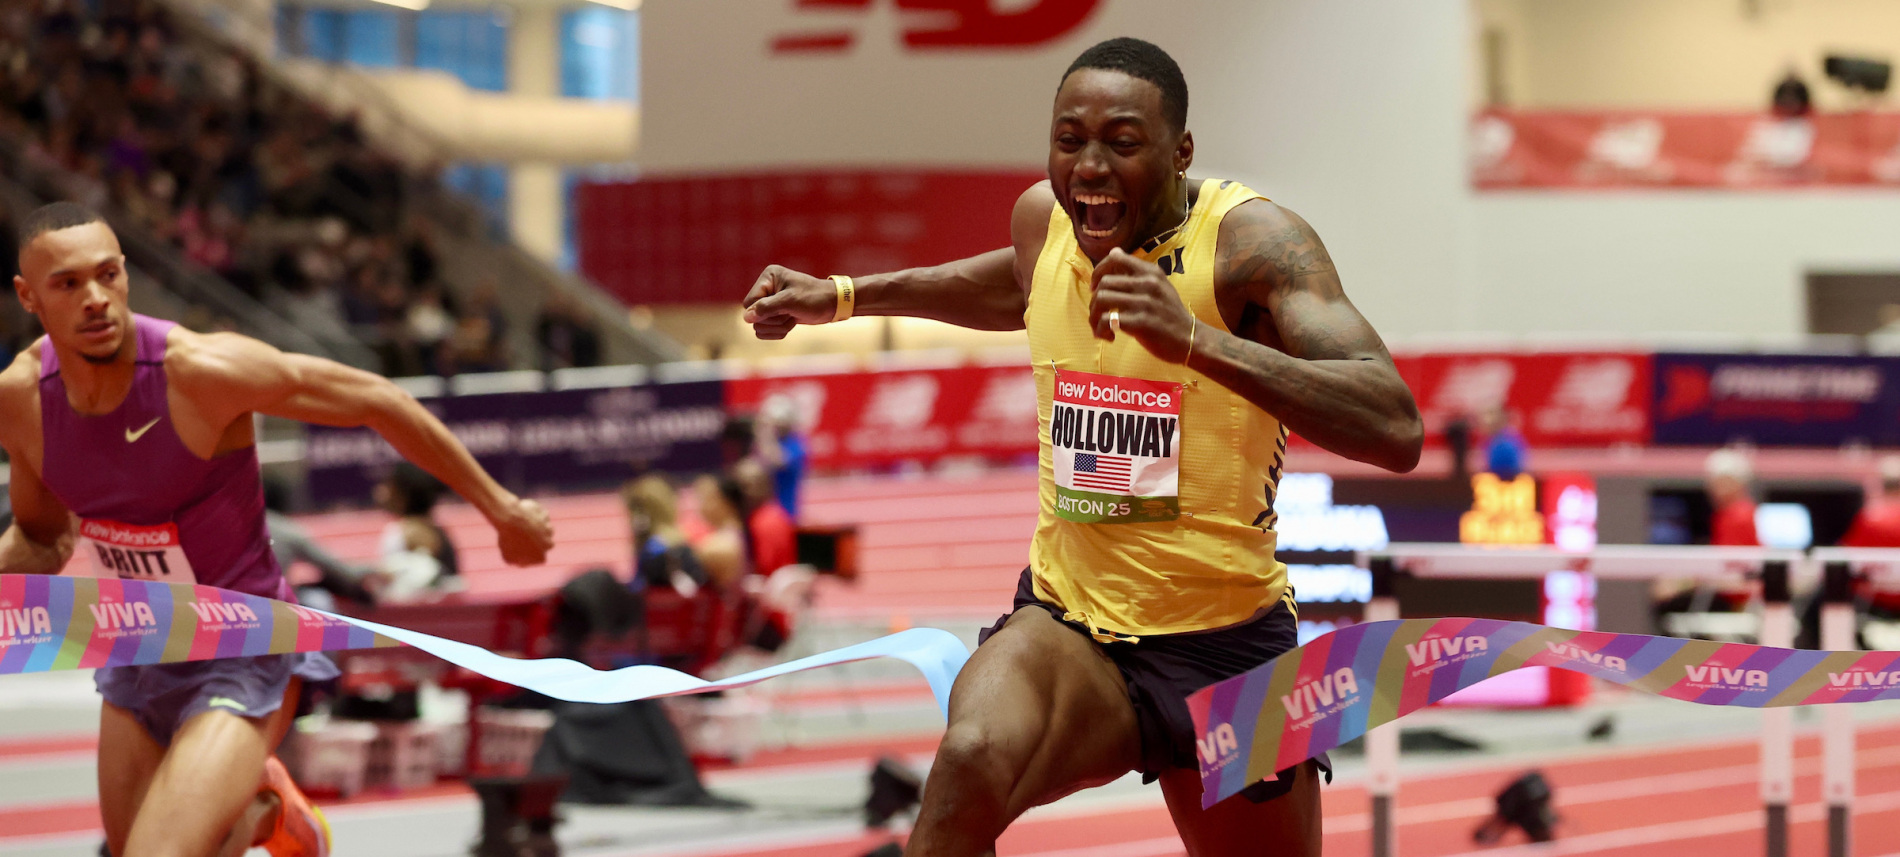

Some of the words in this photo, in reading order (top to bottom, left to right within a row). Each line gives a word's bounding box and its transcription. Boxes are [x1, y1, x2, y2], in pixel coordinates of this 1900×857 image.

[1058, 381, 1086, 399] new
[1089, 381, 1172, 408] balance
[1052, 405, 1177, 458] HOLLOWAY
[1058, 493, 1104, 516] BOSTON
[1108, 503, 1131, 516] 25
[84, 522, 110, 538] new
[110, 527, 171, 545] balance
[93, 542, 171, 575] BRITT
[0, 606, 52, 637] IVA
[89, 602, 156, 629] VIVA
[188, 602, 258, 622] VIVA
[1405, 635, 1488, 667] VIVA
[1545, 640, 1627, 671] VIVA
[1684, 664, 1768, 687] VIVA
[1281, 667, 1358, 721] VIVA
[1197, 722, 1238, 765] VA
